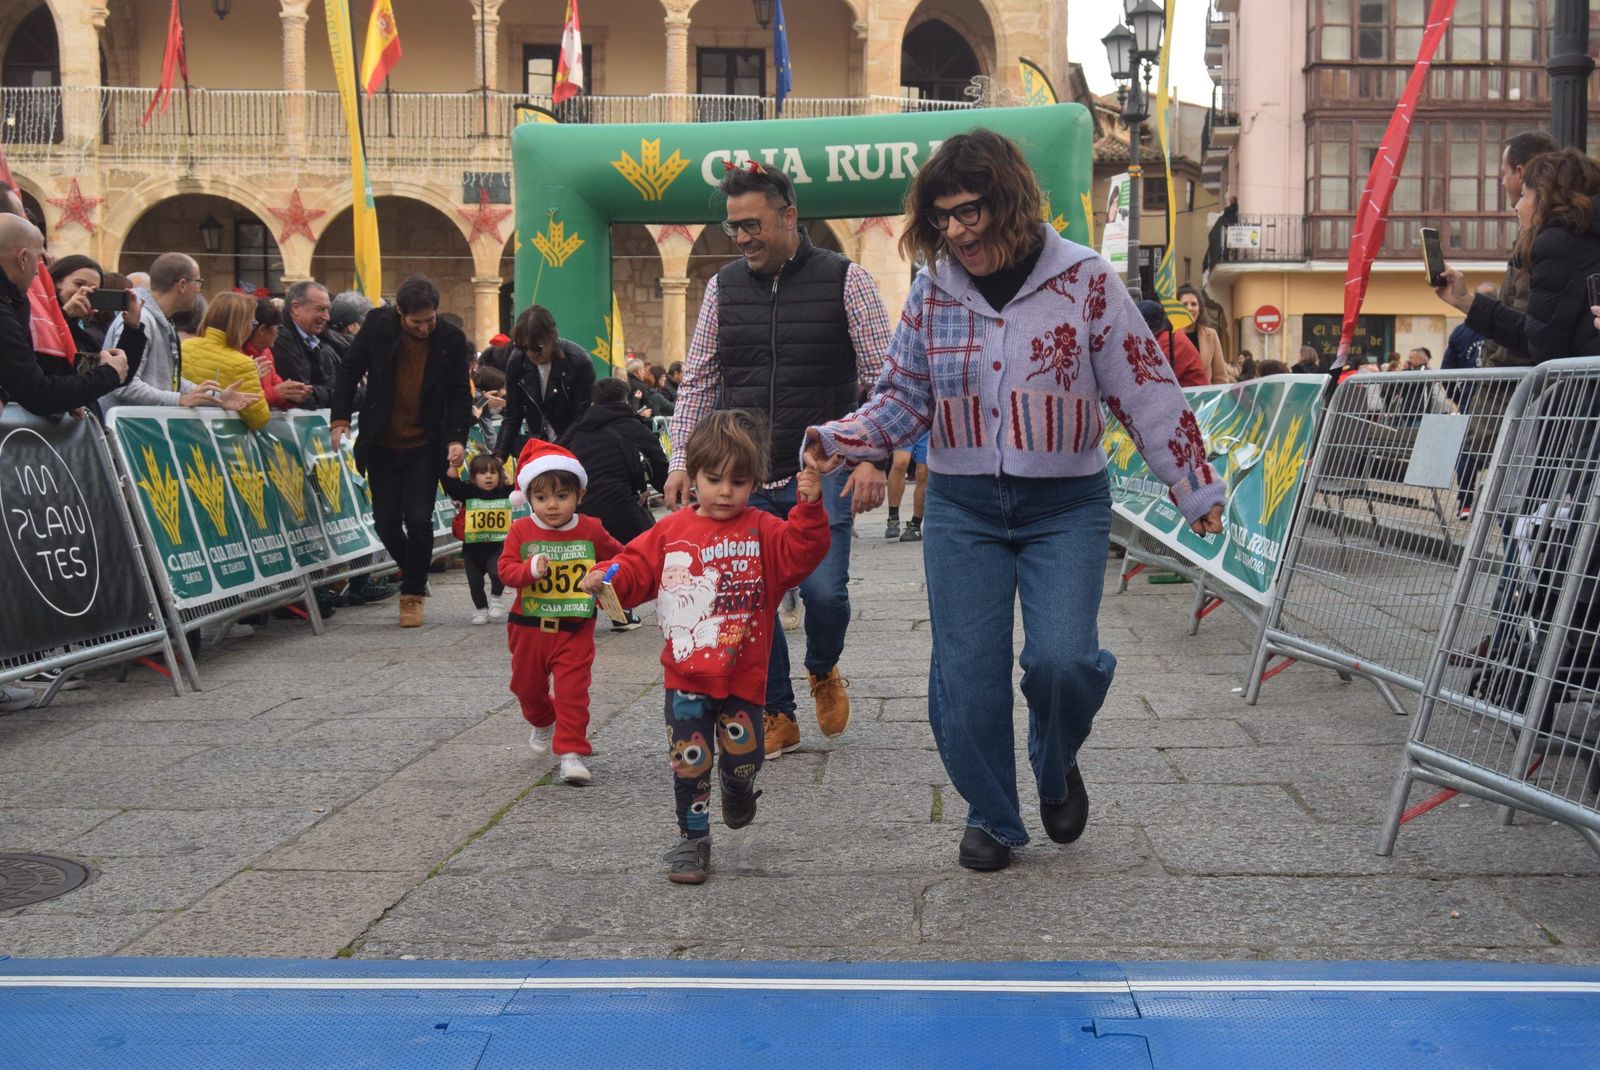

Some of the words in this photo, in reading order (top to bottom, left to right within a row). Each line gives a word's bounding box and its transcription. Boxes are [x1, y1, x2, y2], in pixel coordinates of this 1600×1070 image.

[825, 140, 944, 182] RUR
[14, 464, 59, 496] IM
[470, 511, 506, 529] 1366
[36, 546, 87, 581] TES
[731, 560, 748, 572] TO
[540, 603, 561, 612] CAJA
[563, 603, 590, 612] RURAL
